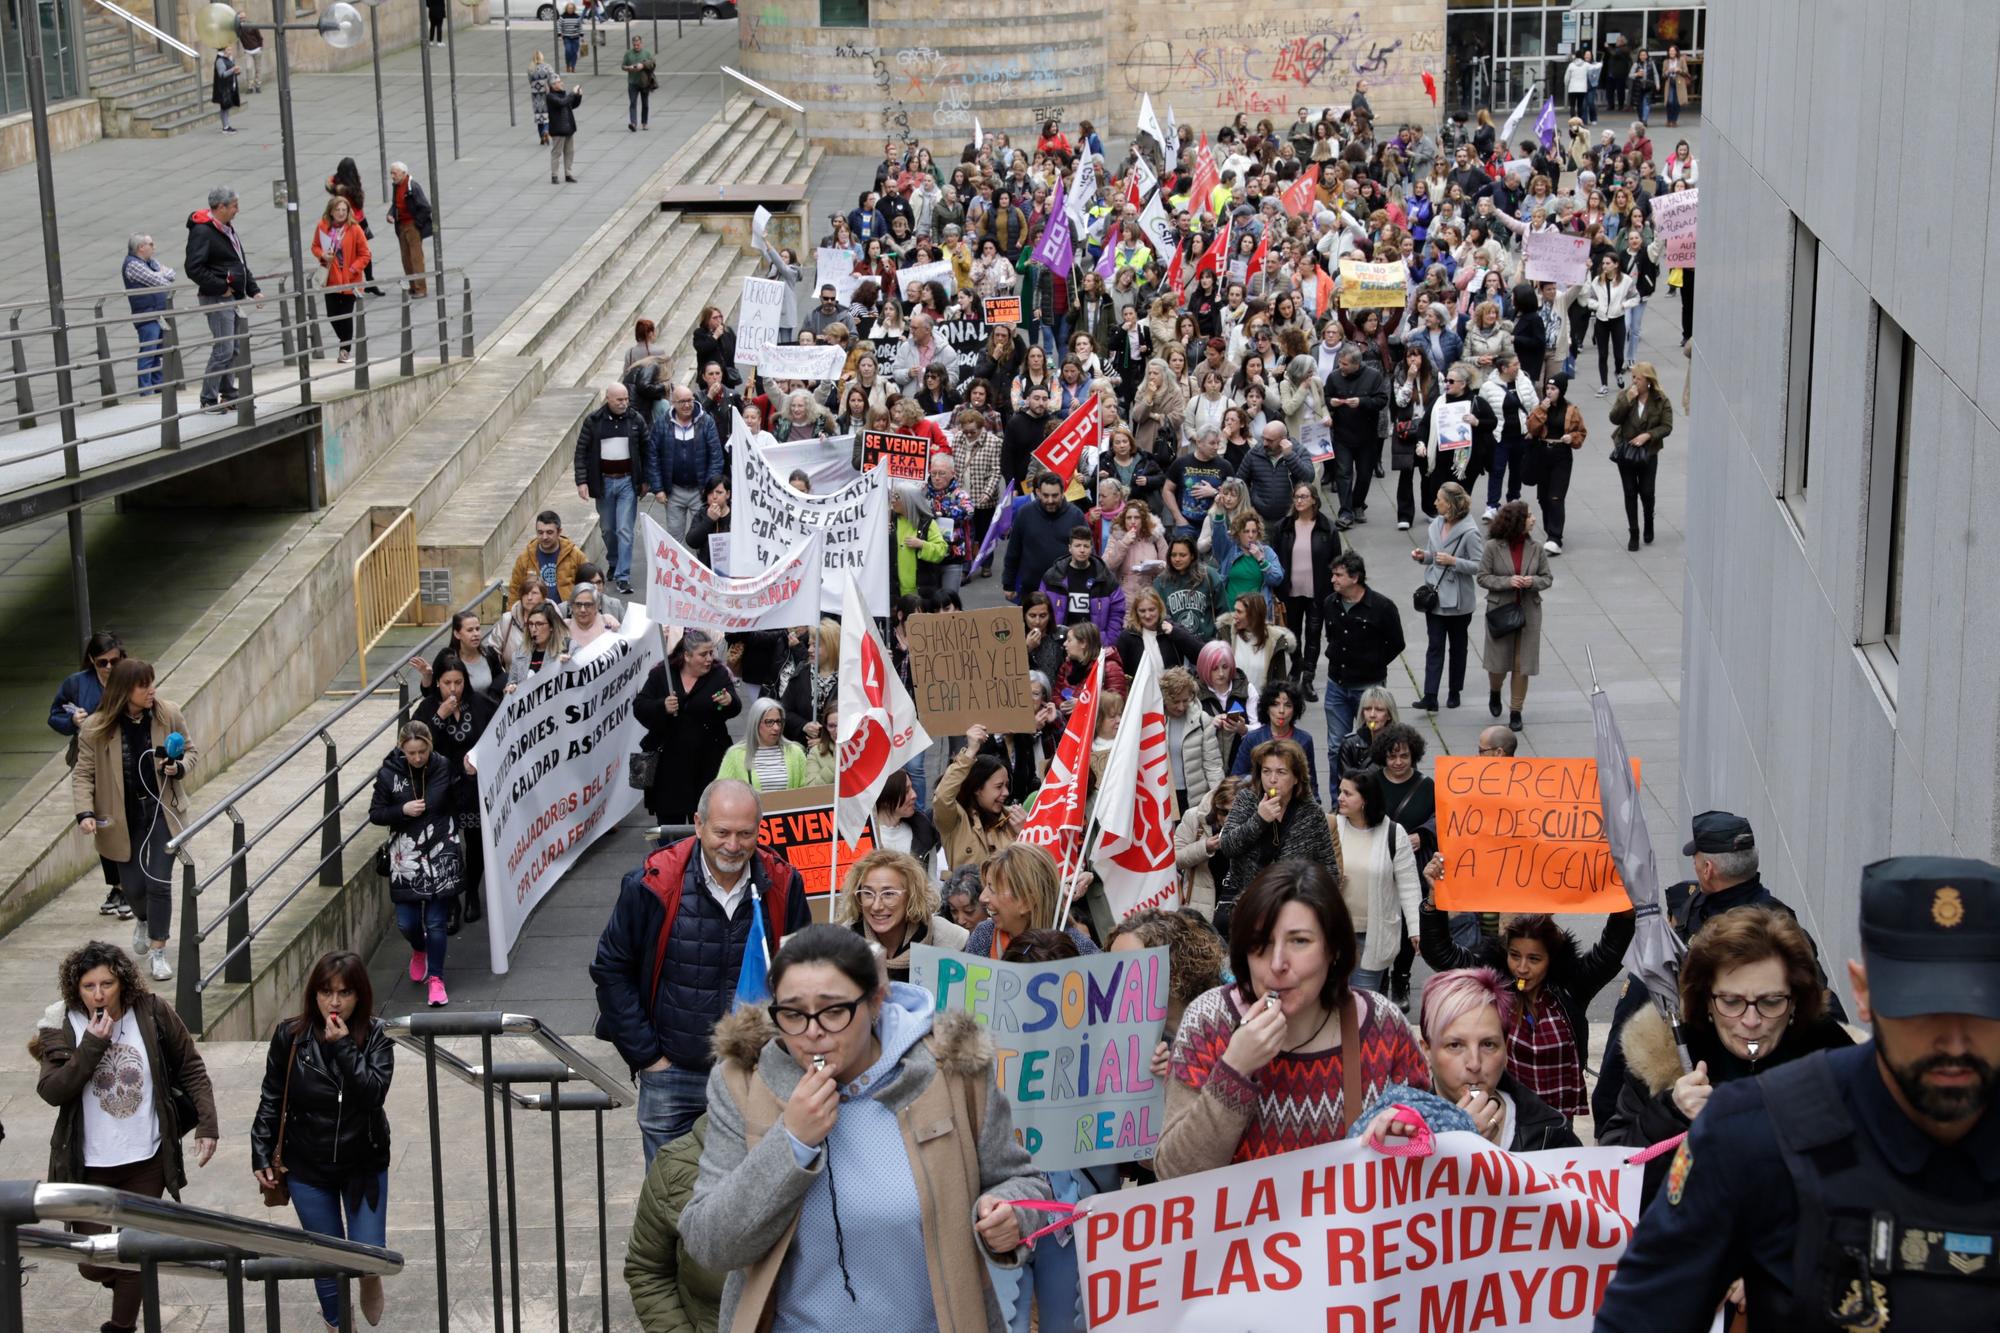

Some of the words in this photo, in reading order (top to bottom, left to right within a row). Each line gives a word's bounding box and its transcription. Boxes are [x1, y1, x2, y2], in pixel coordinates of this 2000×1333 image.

[996, 300, 1019, 308] VENDE
[866, 435, 881, 449] SE
[885, 437, 926, 455] VENDE
[890, 454, 917, 467] ERA
[890, 466, 924, 481] GERENTE
[914, 648, 982, 683] FACTURA
[987, 649, 997, 679] Y
[1004, 647, 1028, 677] EL
[565, 693, 599, 724] SIN
[927, 682, 961, 712] ERA
[968, 682, 981, 711] A
[512, 748, 560, 804] CALIDAD
[566, 692, 635, 762] ASISTENC
[583, 775, 603, 806] DEL
[1447, 761, 1599, 800] GERENT
[757, 818, 787, 847] SE
[1447, 804, 1483, 837] NO
[517, 871, 531, 905] CPR
[531, 837, 565, 883] CLARA
[1454, 848, 1475, 878] A
[1486, 843, 1539, 888] TU
[935, 955, 1168, 1033] PERSONAL
[996, 1032, 1154, 1102] TERIAL
[1074, 1106, 1159, 1153] REAL
[1133, 1149, 1153, 1159] ER
[1086, 1196, 1195, 1263] POR
[1213, 1176, 1280, 1233] LA
[1088, 1256, 1163, 1329] DE
[1181, 1231, 1301, 1301] LAS
[1326, 1198, 1634, 1287] RESIDENC
